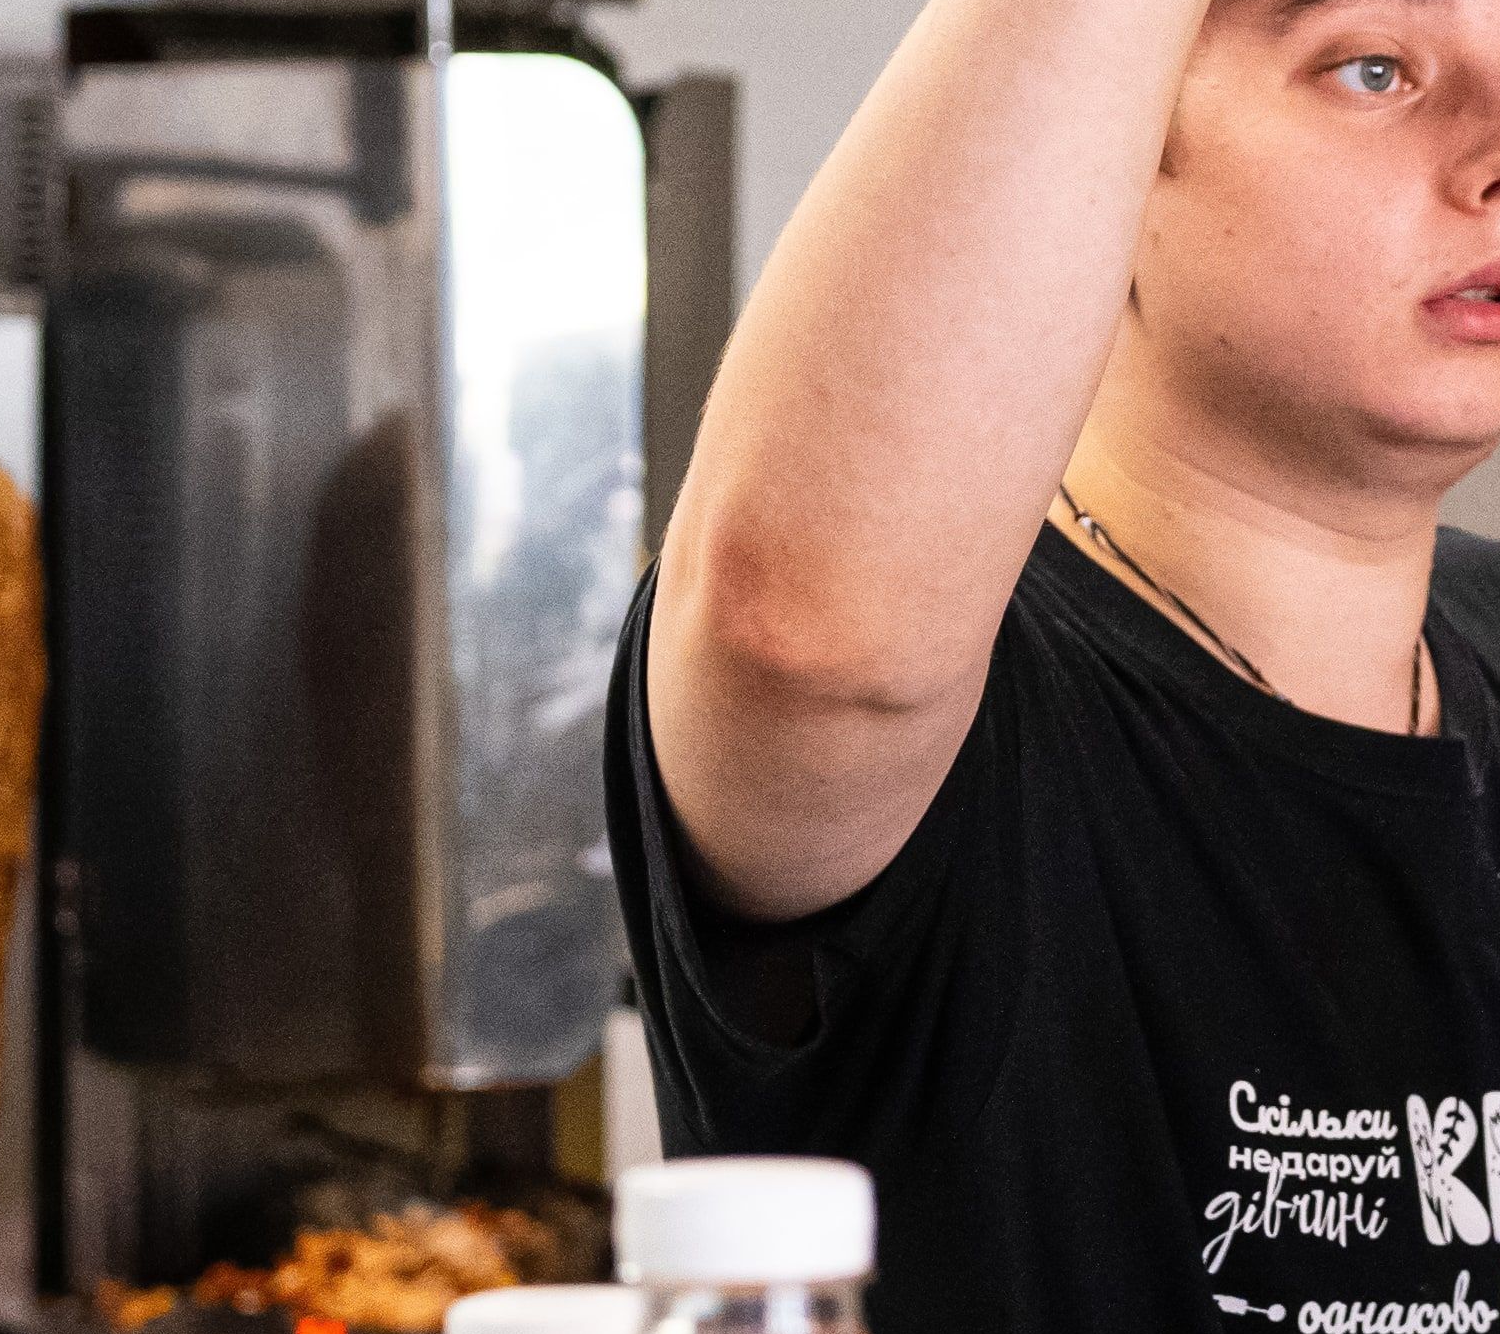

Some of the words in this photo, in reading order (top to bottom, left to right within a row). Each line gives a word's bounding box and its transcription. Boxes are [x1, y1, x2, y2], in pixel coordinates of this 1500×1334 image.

[1229, 1080, 1398, 1140] Скільки
[1229, 1145, 1273, 1173] не
[1281, 1146, 1401, 1184] даруй
[1202, 1157, 1388, 1274] дівчині
